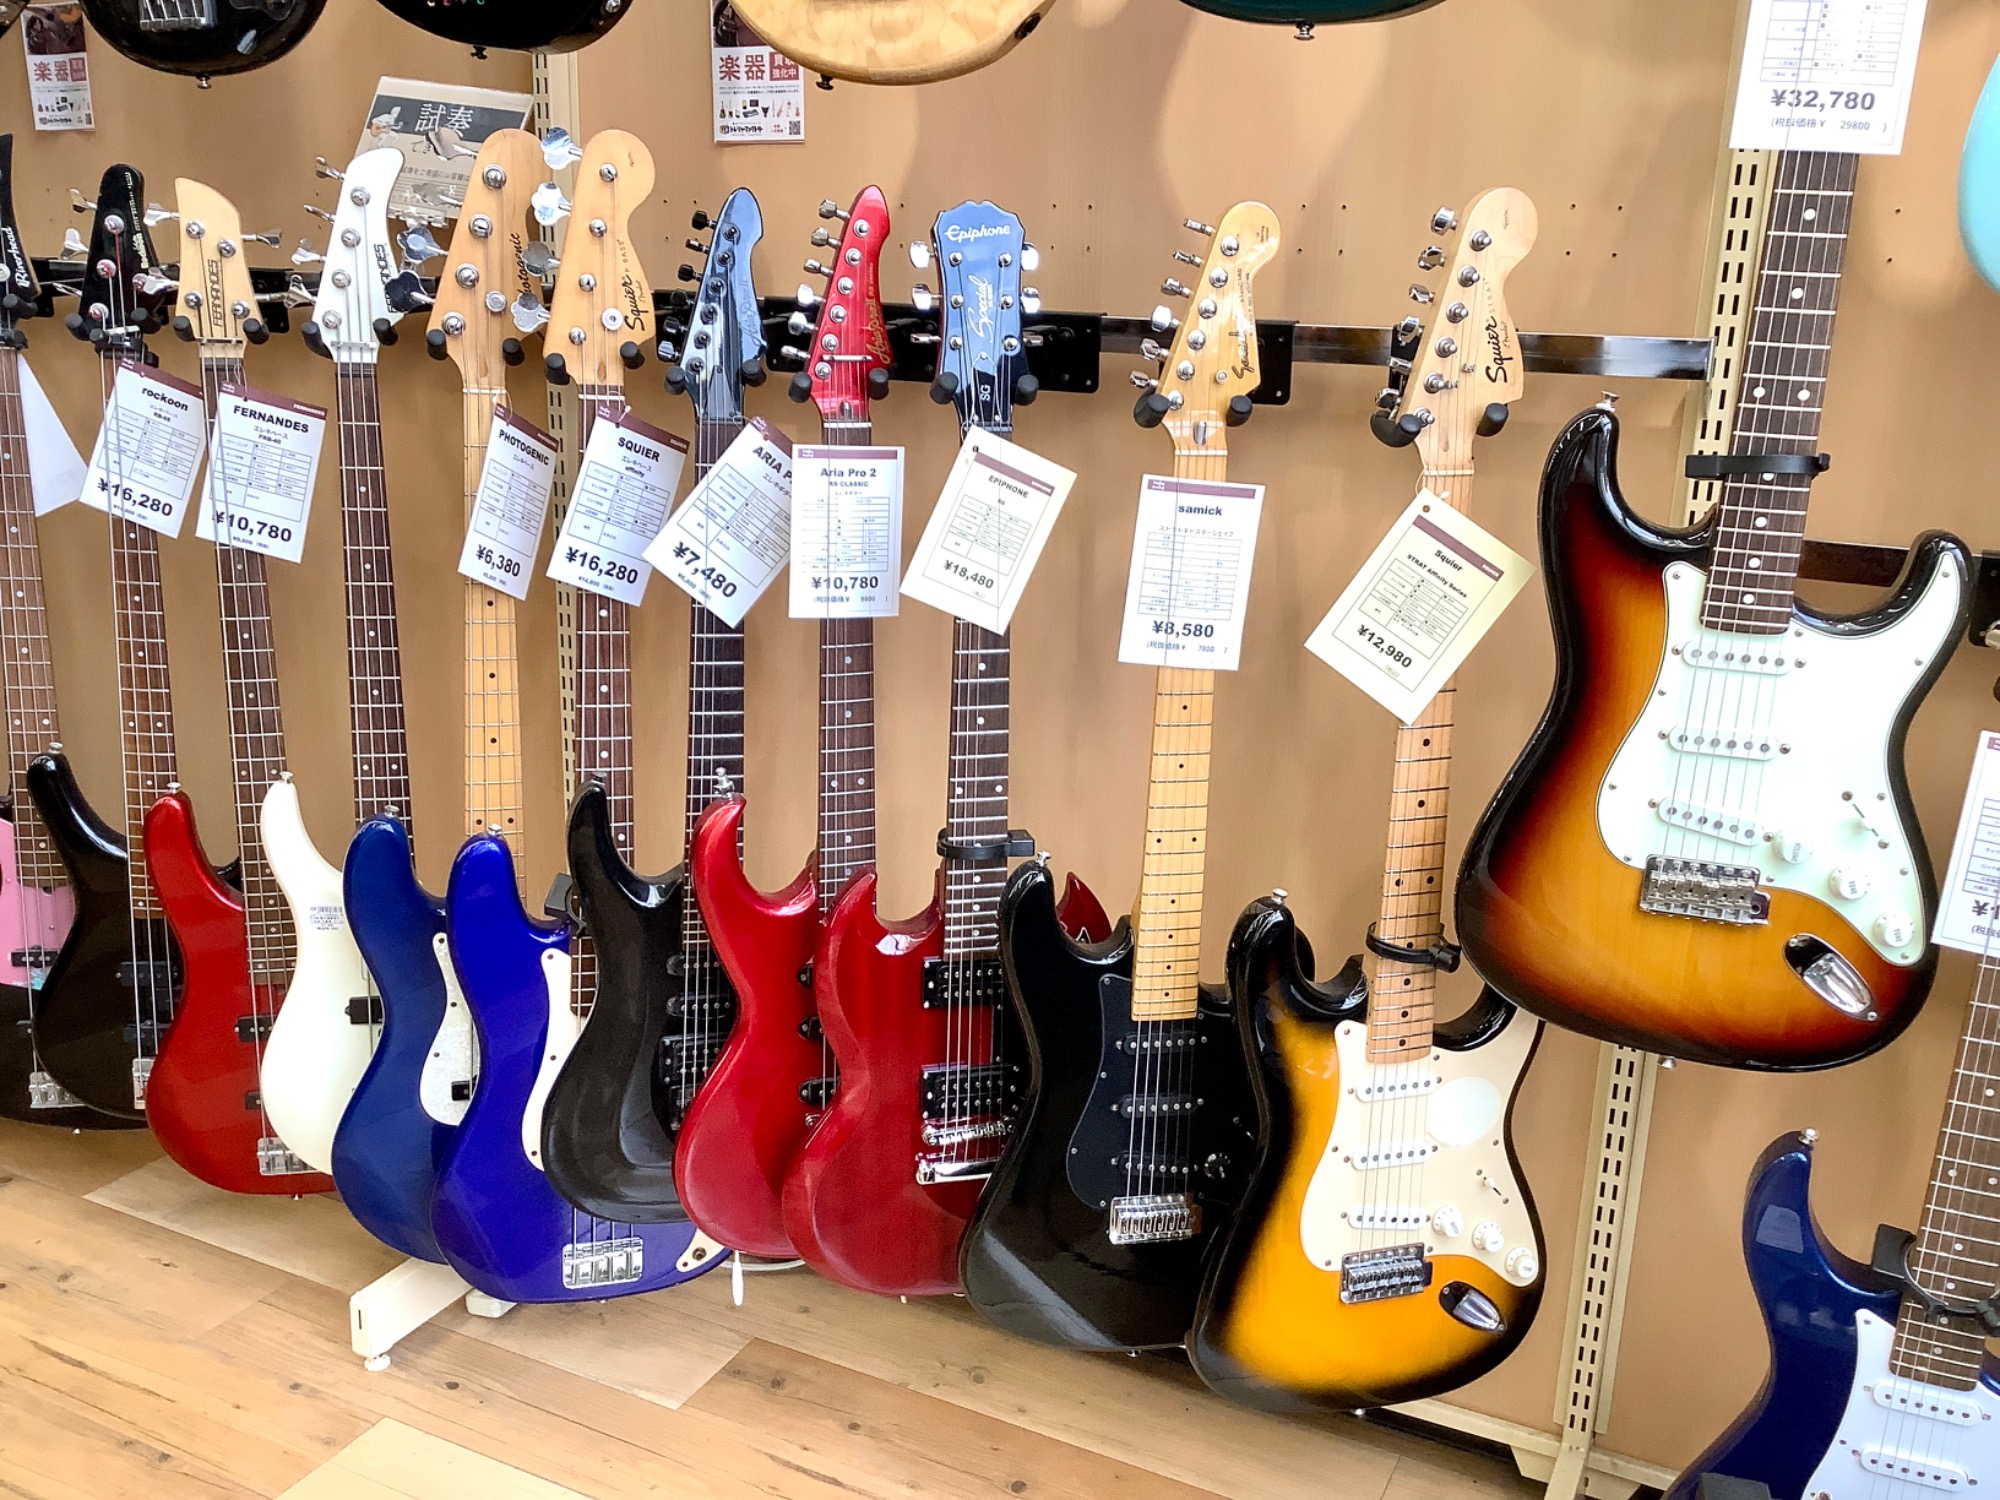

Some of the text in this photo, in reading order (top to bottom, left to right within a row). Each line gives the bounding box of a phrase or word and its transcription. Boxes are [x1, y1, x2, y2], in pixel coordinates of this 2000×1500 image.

[34, 61, 69, 82] 楽器
[719, 54, 765, 81] 楽器
[1770, 88, 1876, 113] ¥32,780
[415, 103, 474, 138] 試奏
[1839, 120, 1871, 131] 29800
[944, 224, 1011, 244] Epiphone
[1, 226, 30, 288] Riverhead
[207, 258, 223, 327] FERNANDES
[623, 275, 650, 332] Squier
[967, 274, 993, 344] Special
[1485, 315, 1514, 384] Squier
[142, 386, 189, 412] rockoon
[979, 384, 991, 402] SG
[233, 405, 309, 433] FERNANDES
[498, 430, 550, 466] PHOTOGENIC
[617, 437, 660, 463] SQUIER
[752, 445, 785, 476] ARIA
[820, 467, 877, 478] Aria Pro 2
[840, 480, 869, 488] CLASSIC
[988, 474, 1029, 499] EPIPHONE
[97, 477, 173, 517] ¥16,280
[1178, 504, 1223, 517] samick
[212, 510, 293, 543] ¥10,780
[475, 544, 521, 578] ¥6,380
[565, 546, 639, 585] ¥16,280
[673, 541, 738, 599] ¥7,480
[943, 559, 994, 590] ¥18,480
[1435, 549, 1463, 573] Squier
[811, 575, 879, 592] ¥10,780
[1407, 554, 1468, 599] STRAT Affinity Series
[1152, 619, 1215, 639] ¥8,580
[1198, 645, 1215, 653] 7800
[1357, 624, 1413, 669] ¥12,980
